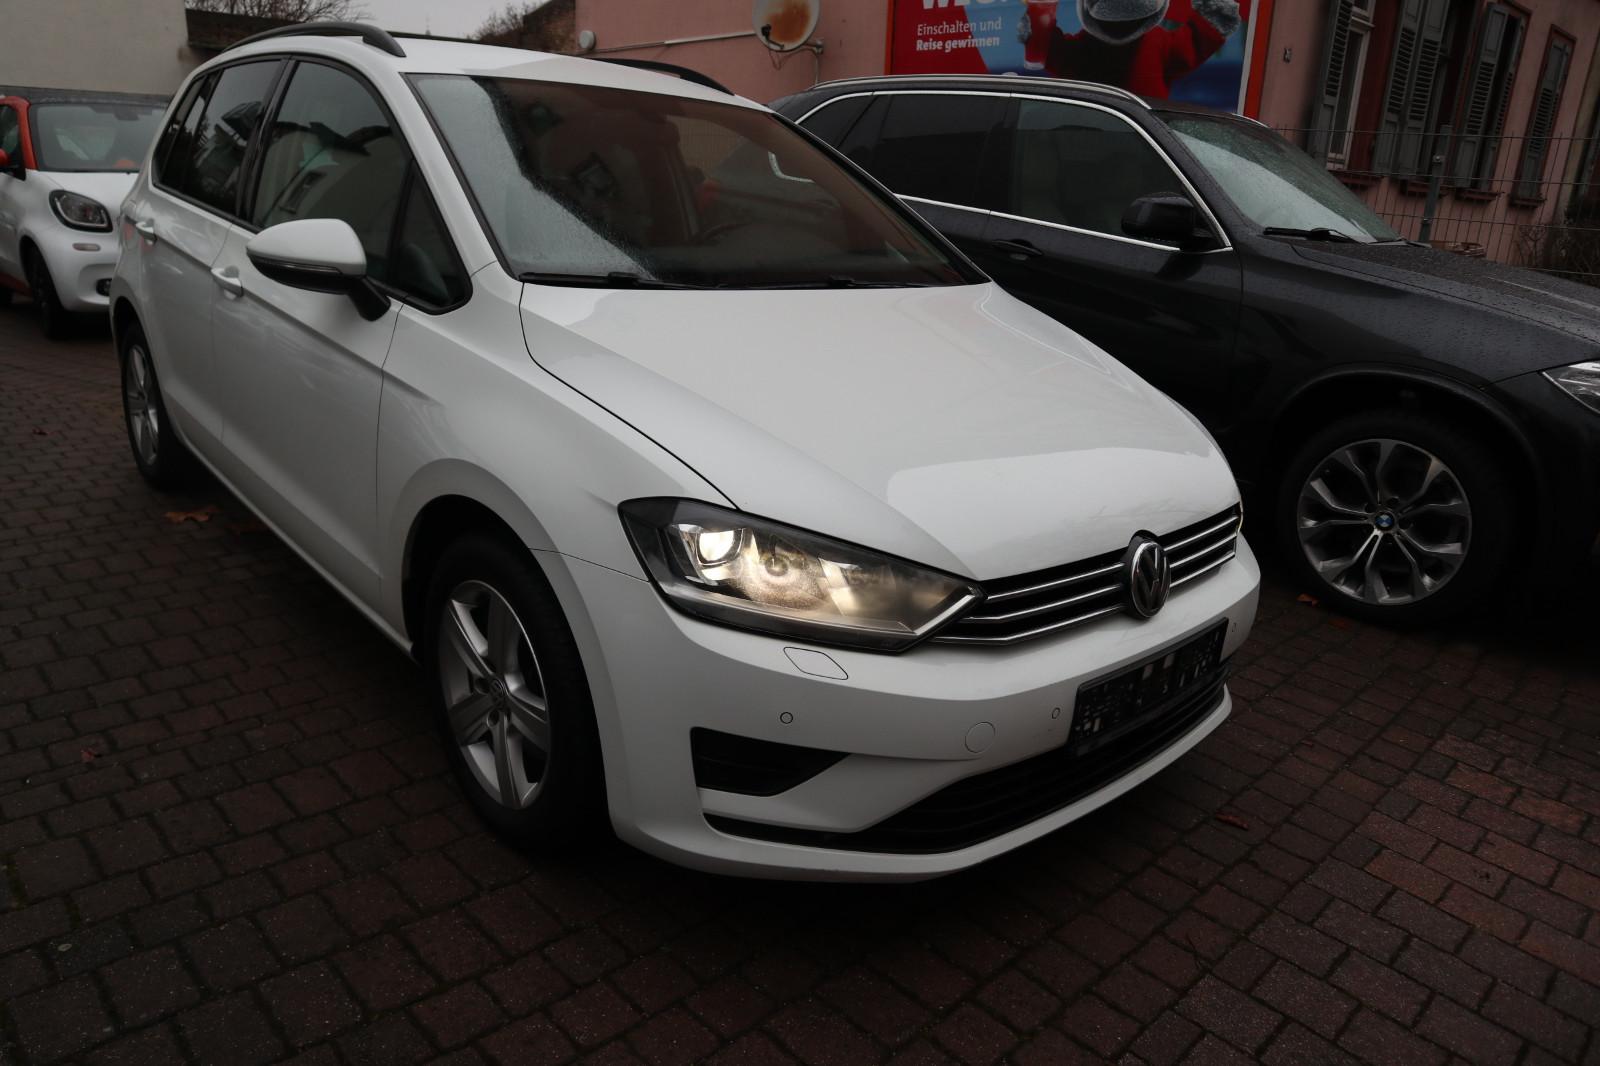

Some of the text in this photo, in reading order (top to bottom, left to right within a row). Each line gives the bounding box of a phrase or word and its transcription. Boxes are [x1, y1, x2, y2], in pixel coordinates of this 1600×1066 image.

[917, 16, 1002, 36] Einschalten und
[916, 36, 1000, 53] Reise gewinnen
